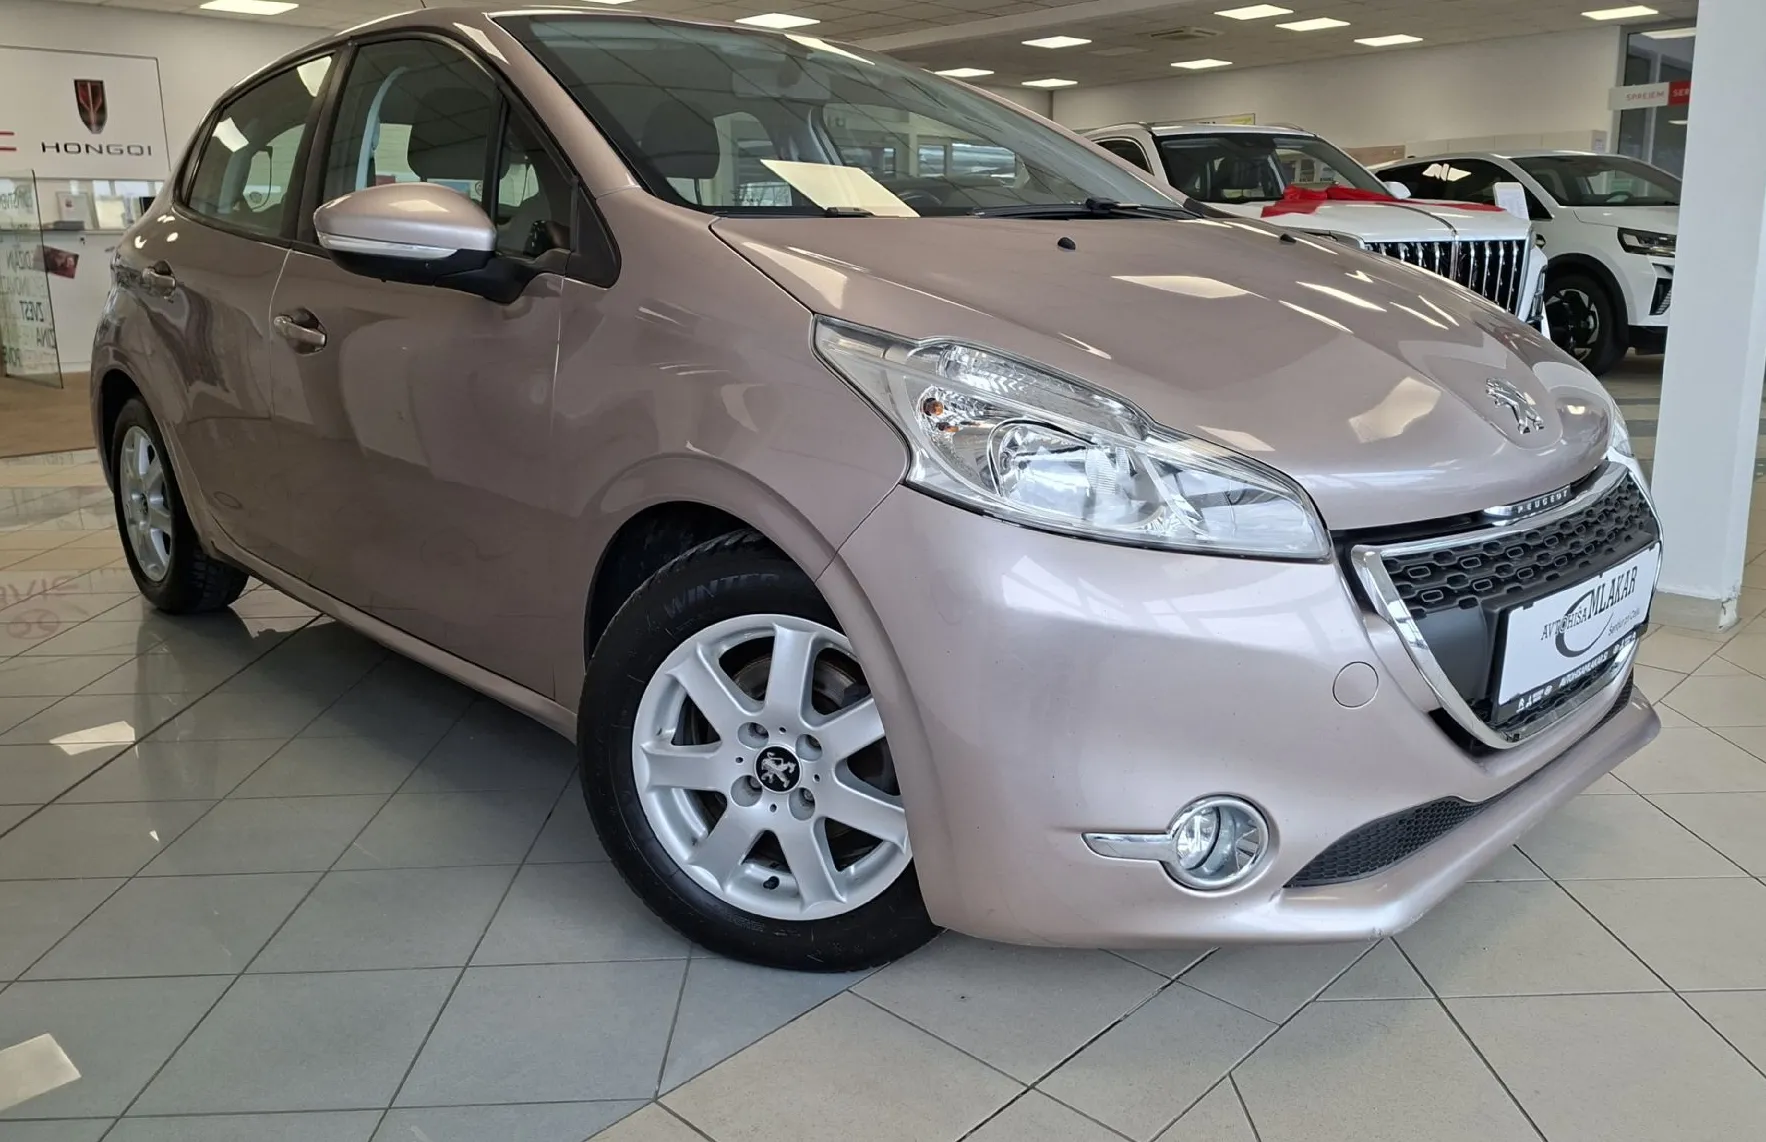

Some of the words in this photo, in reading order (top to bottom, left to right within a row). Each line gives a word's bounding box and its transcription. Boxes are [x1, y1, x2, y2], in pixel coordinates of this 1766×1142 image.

[41, 141, 152, 156] HONGQI
[1517, 489, 1569, 514] PEUGEOT
[1588, 565, 1638, 620] MLAKAR
